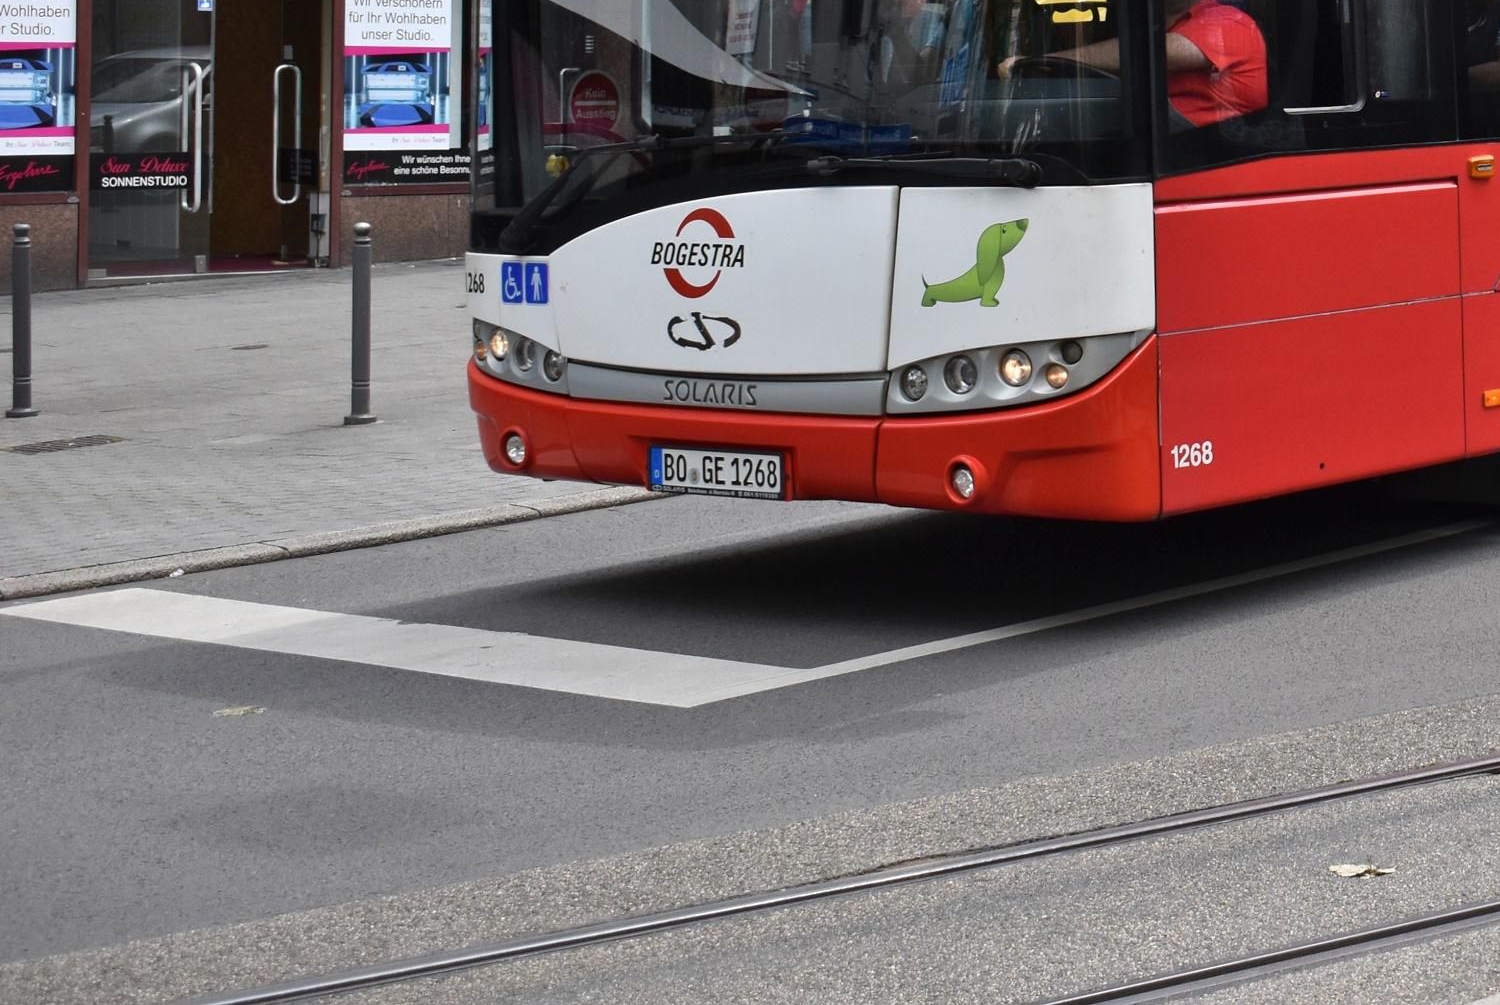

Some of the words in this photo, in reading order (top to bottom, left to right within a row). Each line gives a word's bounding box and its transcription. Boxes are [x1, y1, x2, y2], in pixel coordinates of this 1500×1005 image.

[349, 11, 363, 24] für
[367, 12, 382, 24] Ihr
[385, 12, 446, 26] Wohlhaben
[10, 22, 55, 36] Studio.
[361, 30, 392, 41] unser
[396, 28, 434, 42] Studio.
[585, 87, 607, 100] Kein
[575, 108, 616, 122] Ausstieg
[101, 157, 131, 174] Sun
[139, 156, 190, 174] Deluxe
[401, 155, 415, 164] Wir
[416, 155, 453, 164] wünschen
[394, 166, 410, 175] eine
[411, 166, 438, 175] schöne
[101, 176, 188, 188] SONNENSTUDIO
[651, 242, 745, 268] BOGESTRA
[663, 379, 758, 406] SOLARIS
[1170, 440, 1213, 469] 1268
[664, 453, 687, 482] BO
[702, 456, 726, 485] GE
[731, 457, 778, 488] 1268
